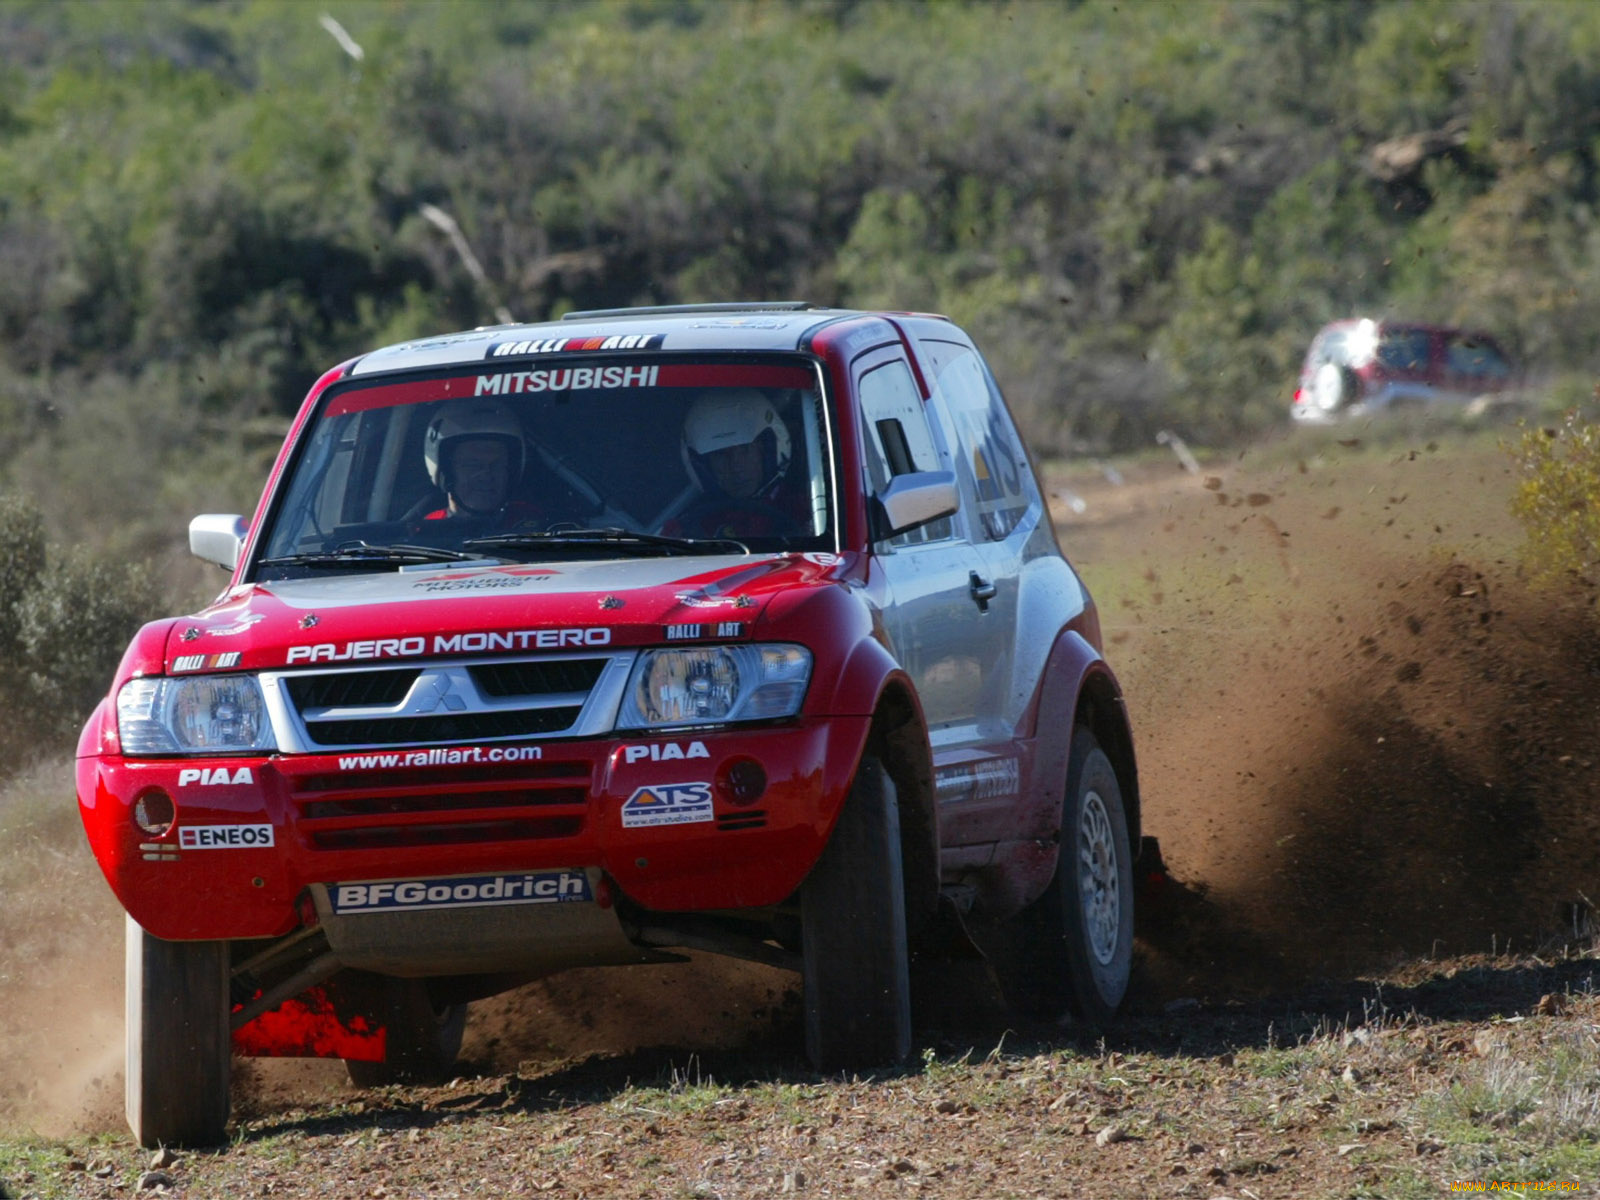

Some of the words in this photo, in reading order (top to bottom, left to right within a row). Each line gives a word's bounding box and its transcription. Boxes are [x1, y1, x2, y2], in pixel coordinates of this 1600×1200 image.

[493, 338, 569, 357] RALLI
[600, 334, 657, 350] ART
[474, 366, 659, 396] MITSUBISHI
[412, 575, 551, 588] MITSUBISHI
[426, 581, 522, 592] MOTORS
[667, 624, 701, 639] RALLI
[717, 622, 741, 637] ART
[286, 637, 425, 664] PAJERO
[433, 628, 611, 653] MONTERO
[172, 654, 206, 672] RALLI
[215, 652, 241, 668] ART
[339, 746, 542, 770] www.ralliart.com
[625, 741, 710, 764] PIAA
[178, 767, 254, 787] PIAA
[625, 783, 710, 809] ATS
[199, 827, 270, 846] ENEOS
[337, 873, 583, 907] BFGoodrich
